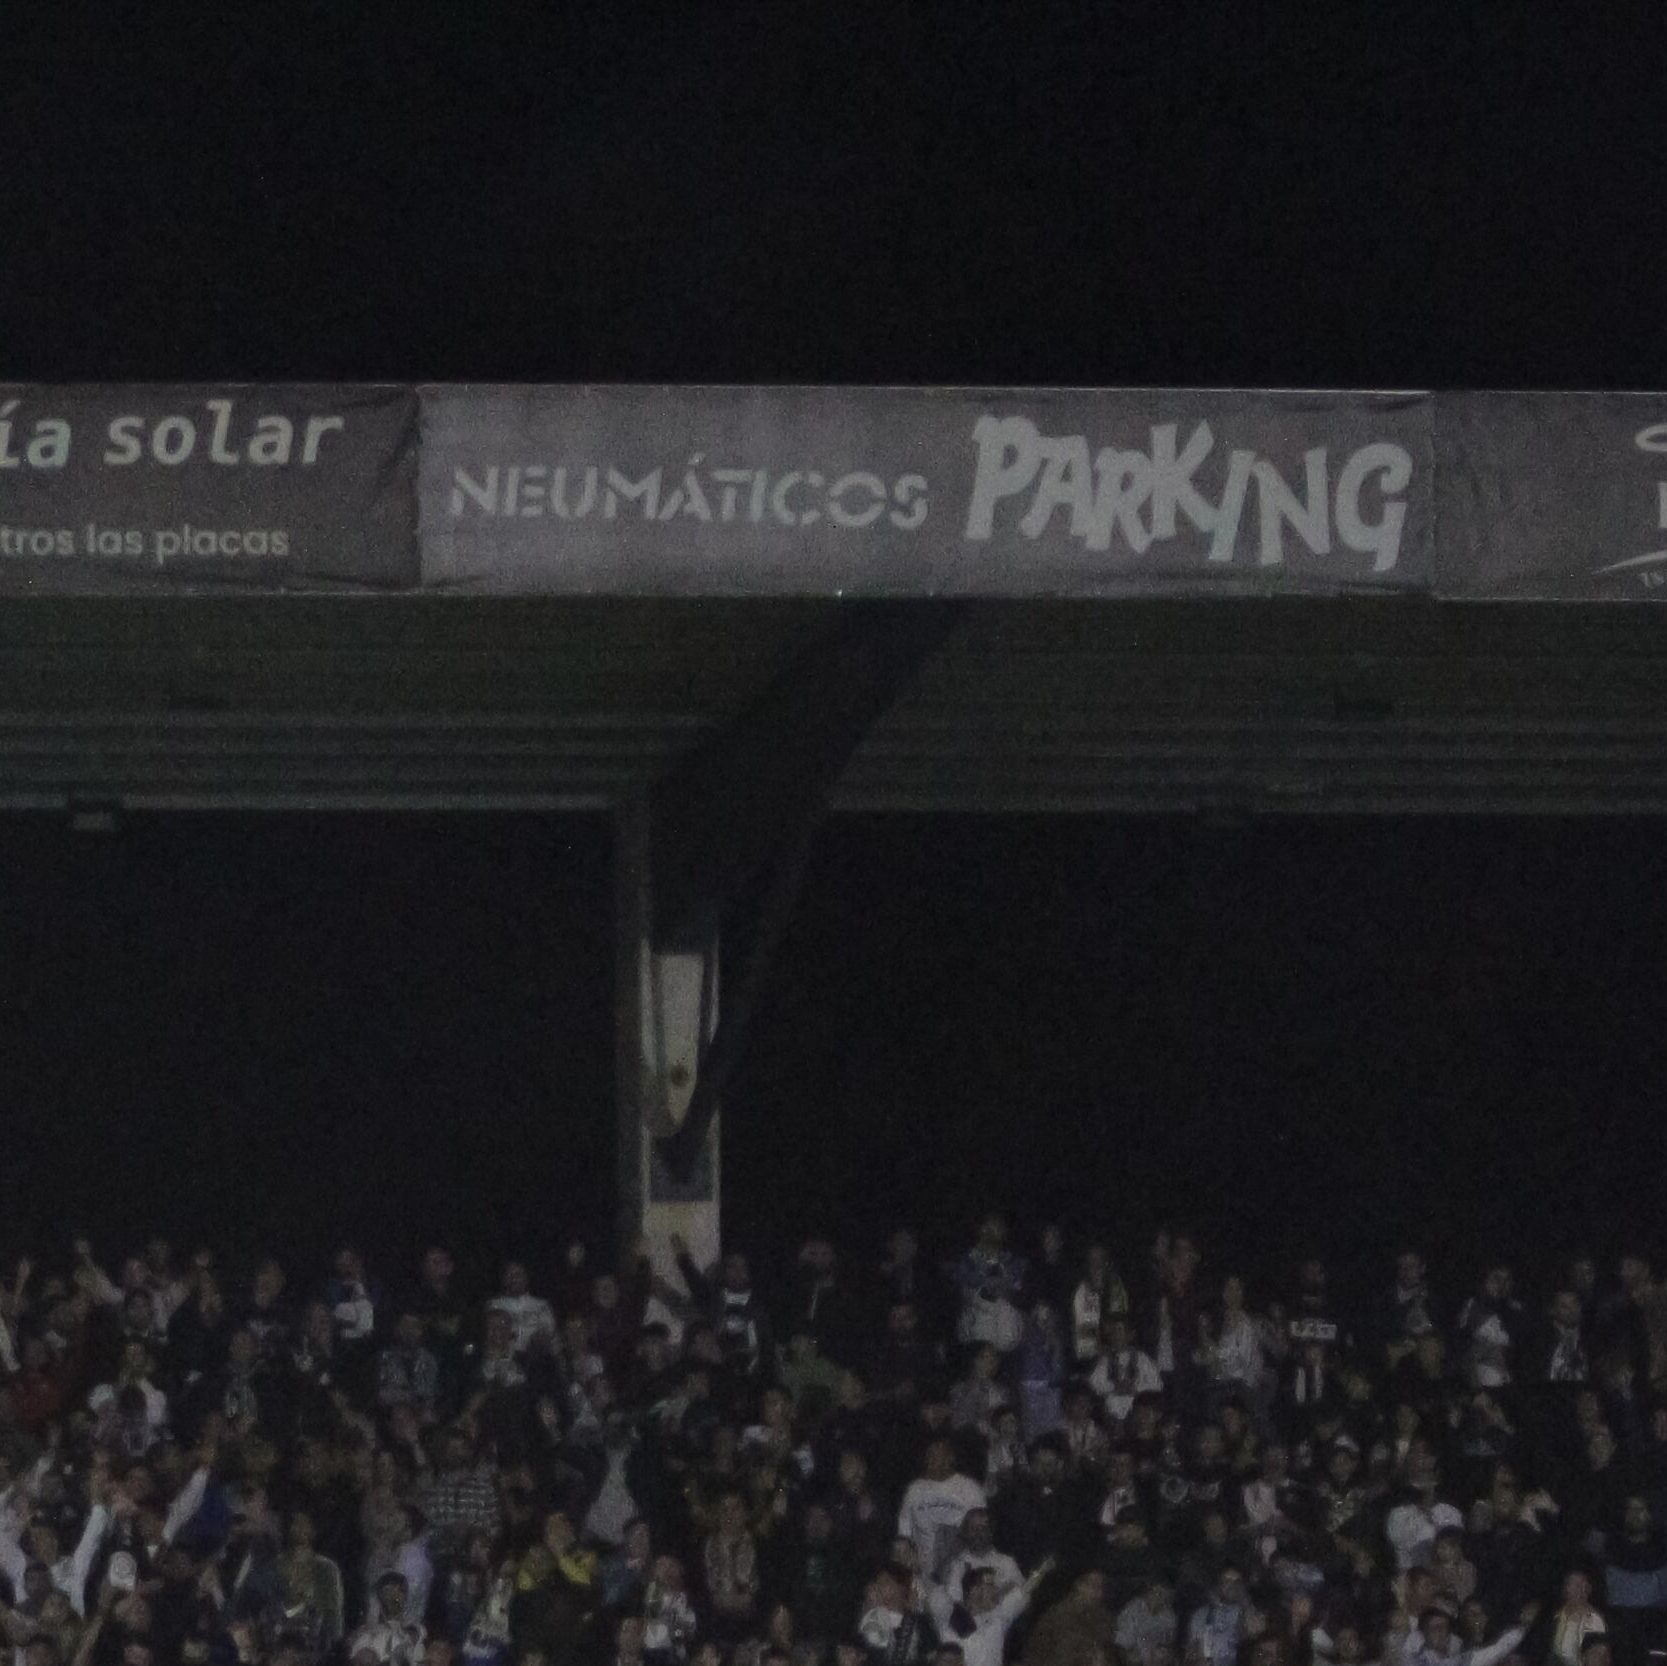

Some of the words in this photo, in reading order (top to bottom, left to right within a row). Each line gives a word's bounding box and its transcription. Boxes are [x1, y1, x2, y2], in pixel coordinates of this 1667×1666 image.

[102, 400, 345, 466] solar
[450, 453, 930, 531] NEUMÁTICOS
[966, 415, 1413, 572] PARKING
[85, 524, 143, 556] las
[156, 524, 291, 565] placas
